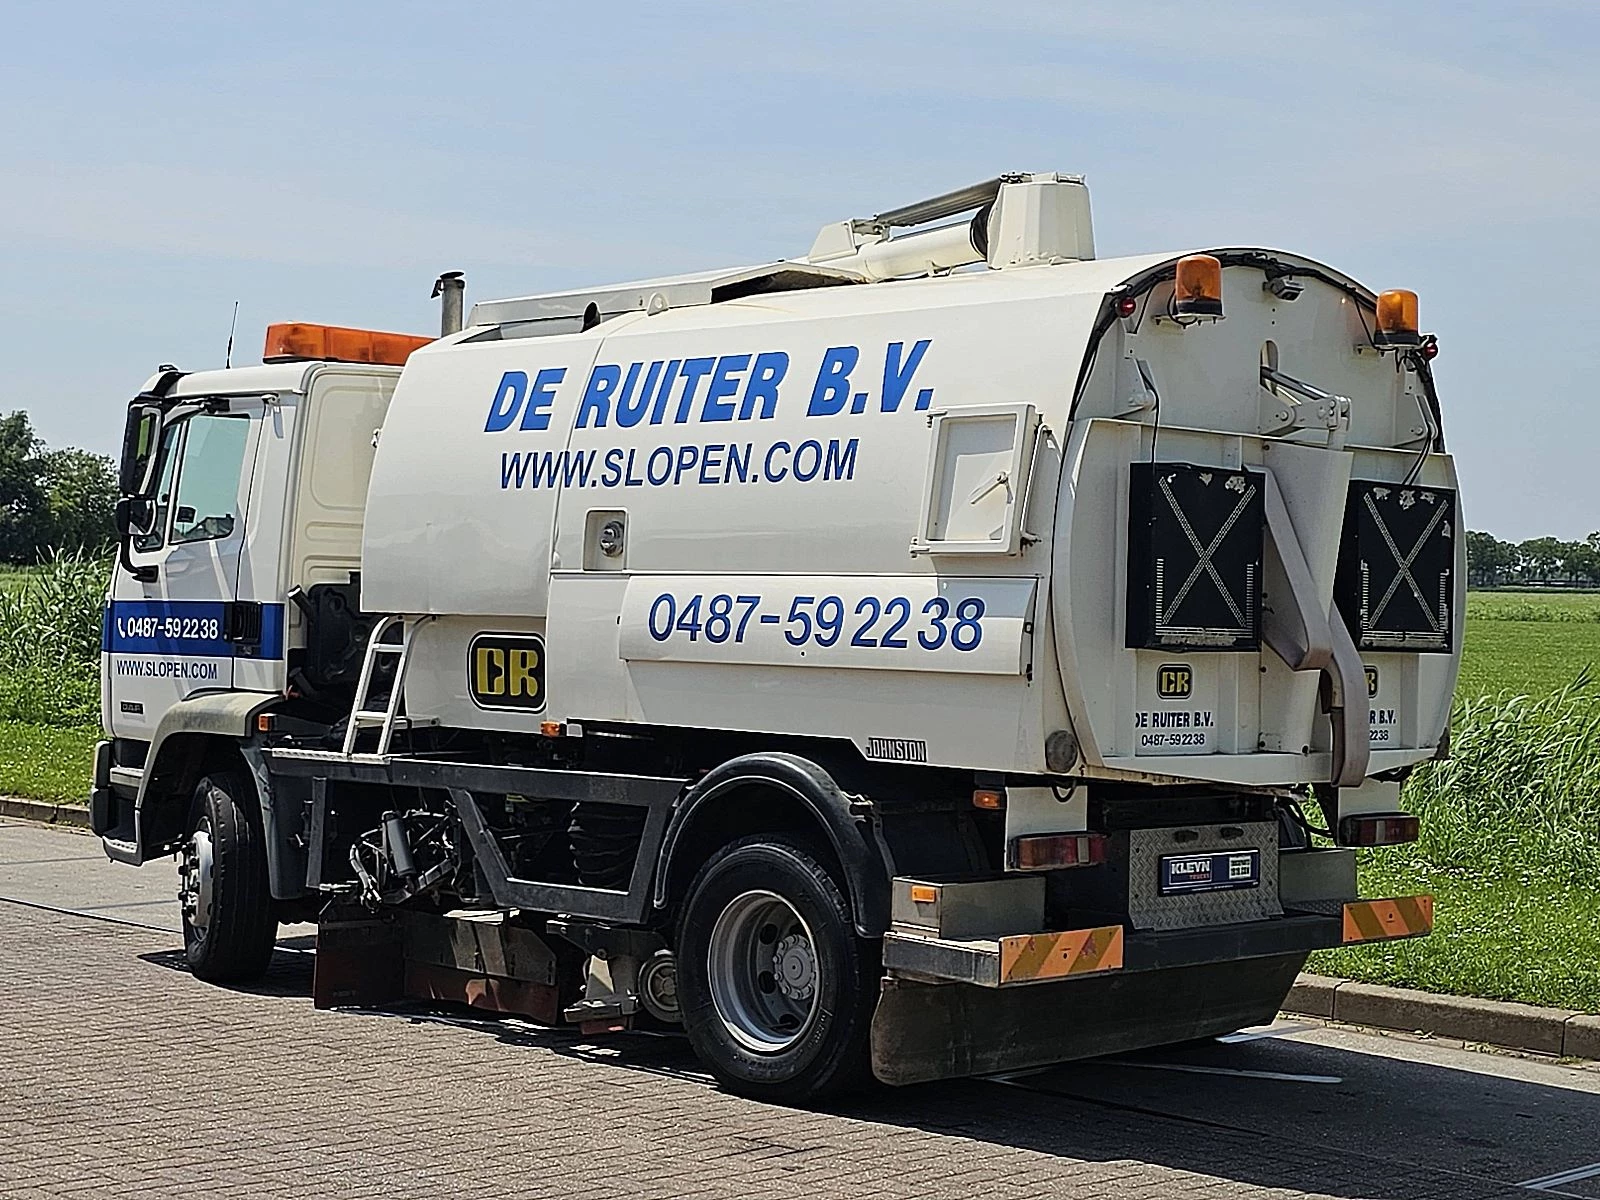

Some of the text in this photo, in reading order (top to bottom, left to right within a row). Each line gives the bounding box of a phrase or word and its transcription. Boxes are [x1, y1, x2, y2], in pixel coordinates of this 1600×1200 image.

[484, 340, 934, 432] DE RUITER B.V.
[501, 439, 859, 489] WWW.SLOPEN.COM
[117, 660, 218, 680] WWW.SLOPEN.COM
[1152, 712, 1190, 728] RUITER
[1194, 711, 1214, 727] B.V.
[1379, 709, 1397, 725] B.V.
[865, 738, 926, 762] JOHNSTON
